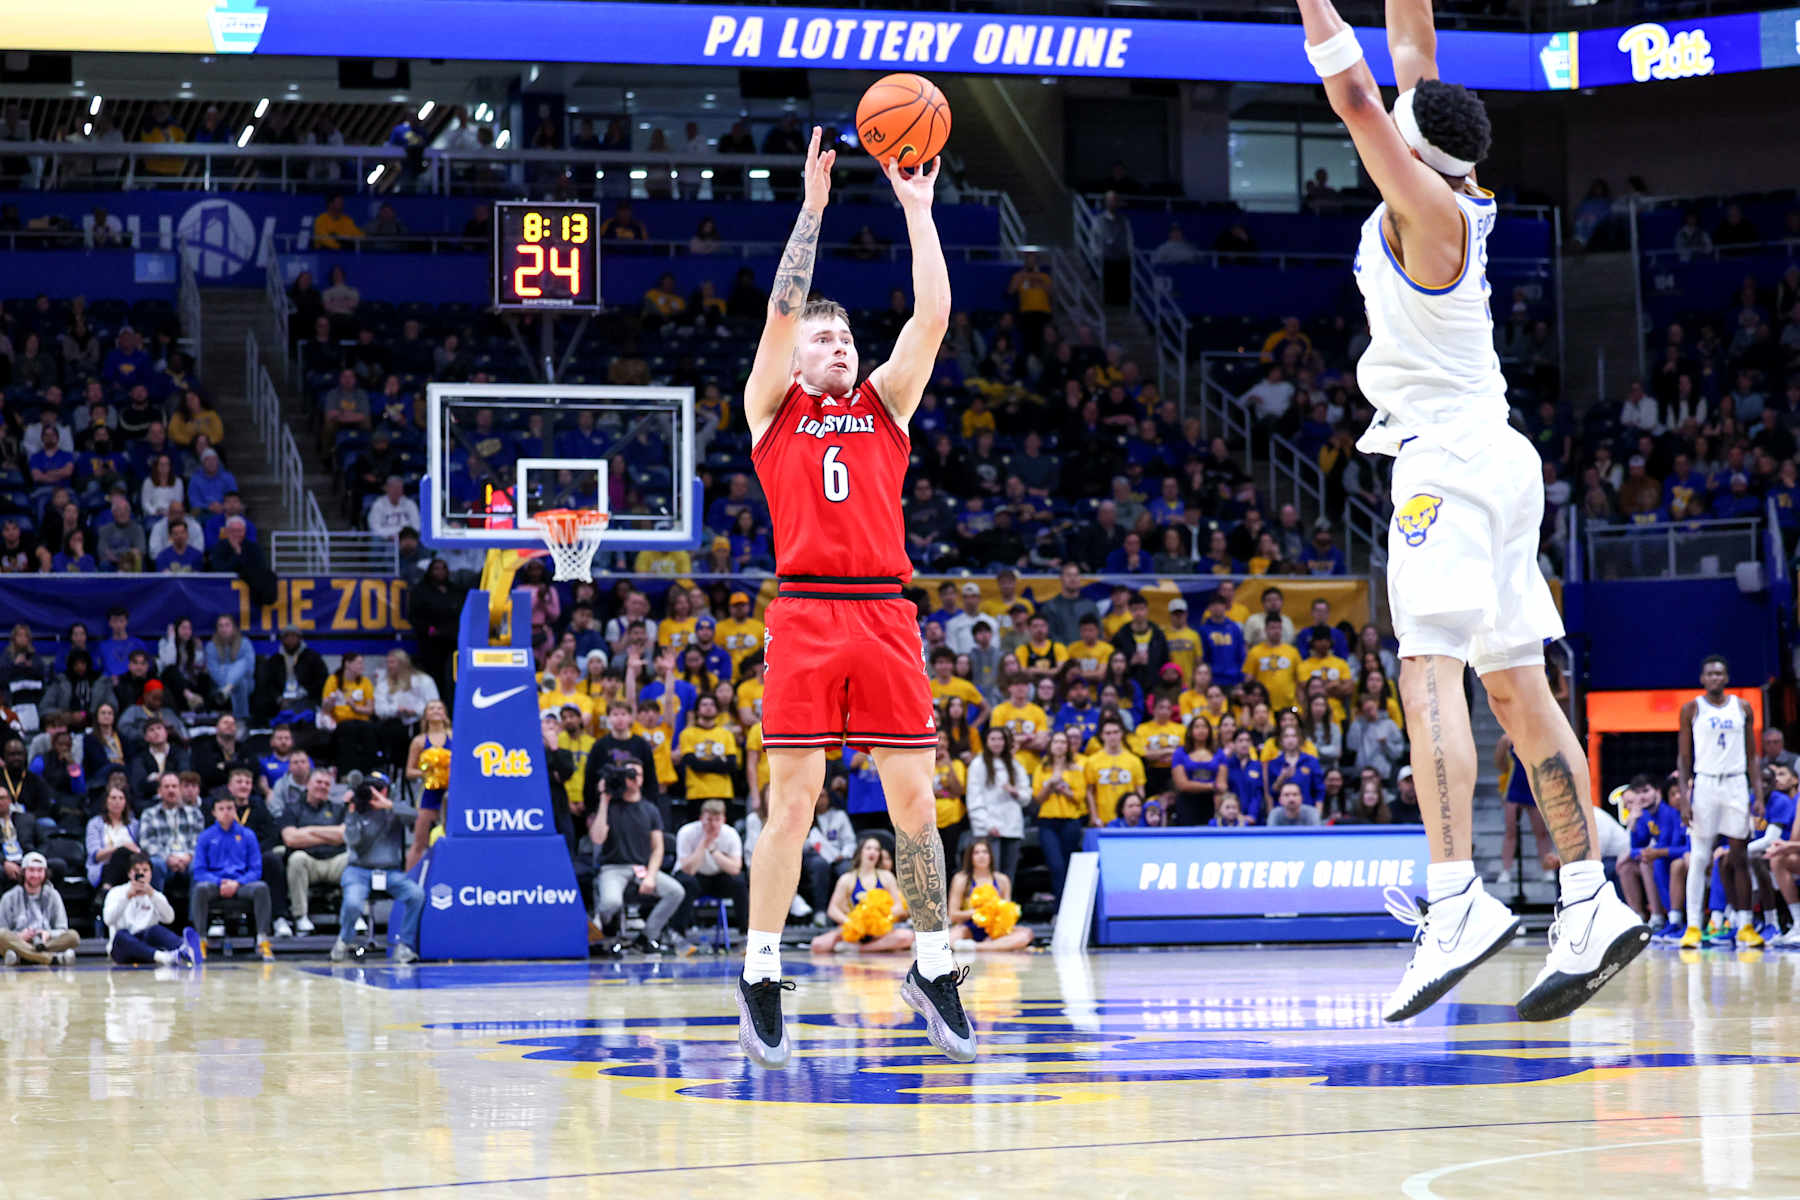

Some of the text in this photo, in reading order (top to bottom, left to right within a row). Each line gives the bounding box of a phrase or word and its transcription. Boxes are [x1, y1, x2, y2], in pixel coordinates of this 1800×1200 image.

[703, 15, 1133, 69] PA LOTTERY ONLINE
[1617, 22, 1715, 82] Pitt
[523, 212, 589, 244] 8:13
[514, 244, 580, 297] 24
[821, 445, 850, 502] 6
[231, 579, 316, 631] THE
[473, 741, 533, 778] Pitt
[464, 808, 545, 832] UPMC
[458, 884, 577, 906] Clearview
[1139, 859, 1416, 891] PA LOTTERY ONLINE
